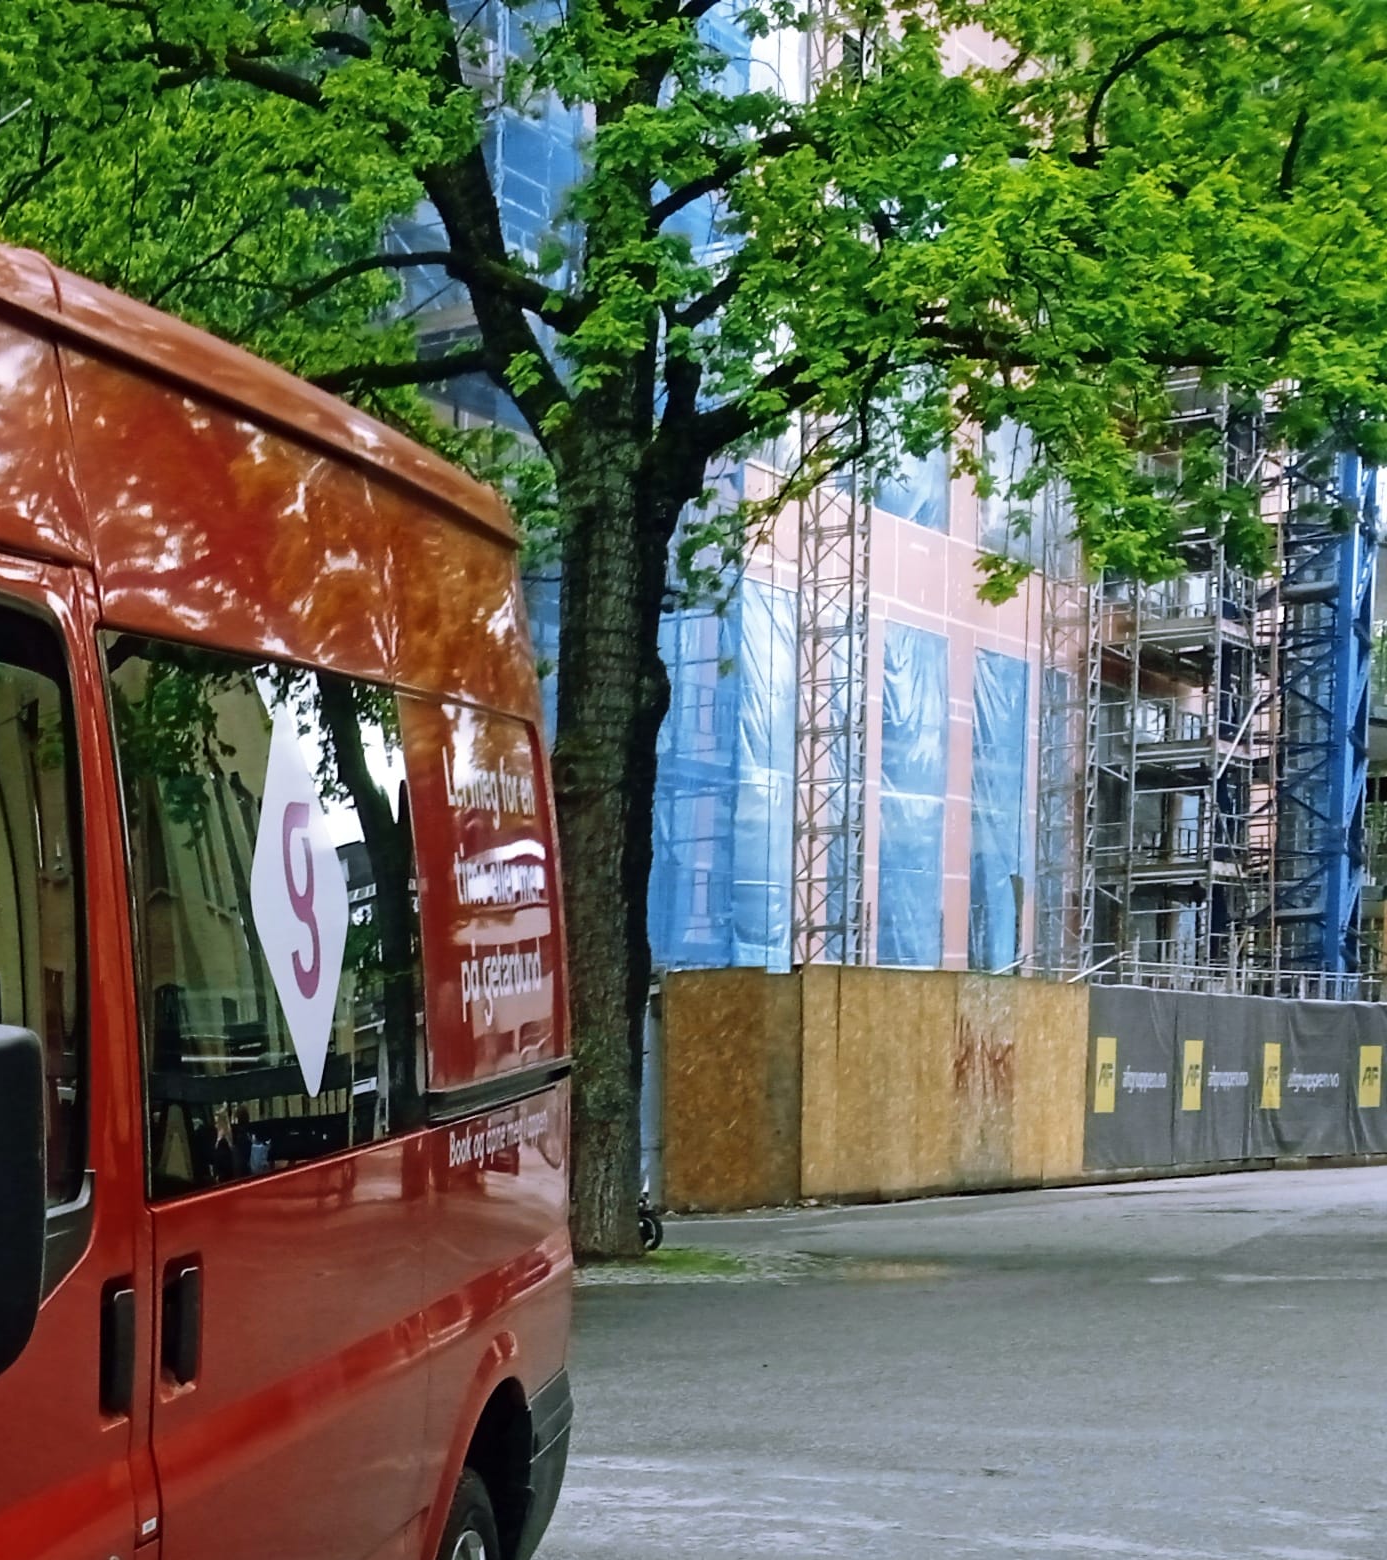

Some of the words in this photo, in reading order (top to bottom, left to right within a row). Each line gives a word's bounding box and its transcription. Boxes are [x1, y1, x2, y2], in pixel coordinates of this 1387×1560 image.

[499, 755, 519, 813] for
[460, 938, 479, 1022] på
[482, 937, 542, 1026] getaround
[449, 1126, 472, 1167] Book
[473, 1132, 485, 1168] og
